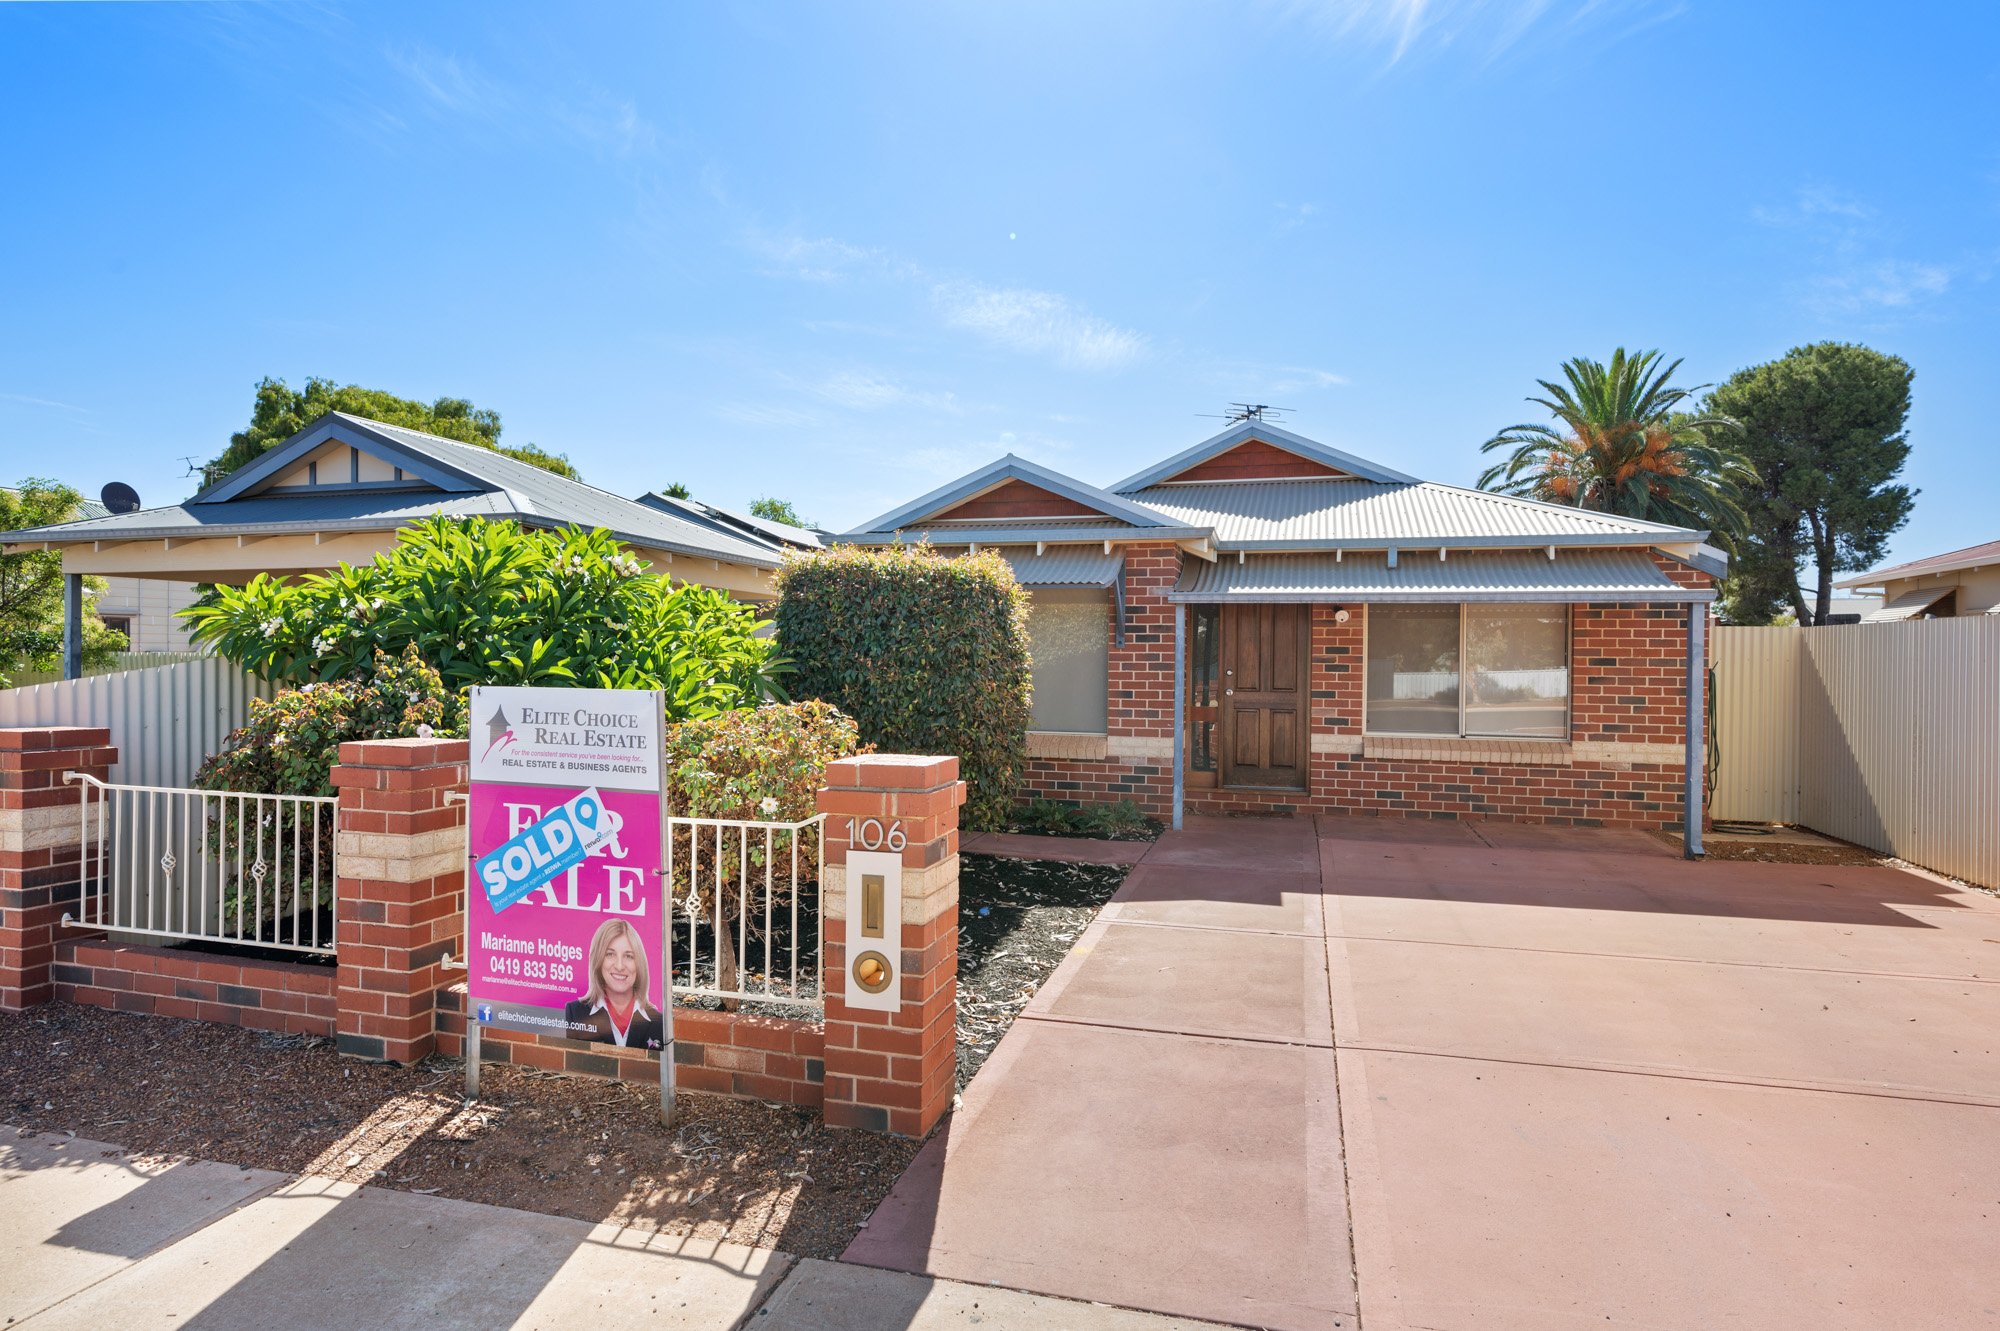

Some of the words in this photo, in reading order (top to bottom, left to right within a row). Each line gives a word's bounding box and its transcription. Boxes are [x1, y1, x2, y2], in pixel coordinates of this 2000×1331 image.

[521, 708, 570, 725] ELITE
[574, 709, 638, 728] CHOICE
[535, 728, 580, 746] REAL
[583, 730, 647, 749] ESTATE
[502, 759, 524, 767] REAL
[526, 760, 556, 769] ESTATE
[560, 761, 565, 769] &
[568, 762, 610, 772] BUSINESS
[611, 764, 647, 774] AGENTS
[531, 750, 558, 758] consistent
[578, 752, 596, 760] you've
[611, 753, 631, 763] looking
[845, 818, 907, 852] 106
[483, 819, 574, 896] SOLD
[508, 889, 517, 899] real
[516, 883, 529, 893] estate
[529, 874, 542, 886] agent
[544, 861, 561, 875] REIWA
[481, 932, 535, 955] Marianne
[538, 938, 583, 963] Hodges
[490, 956, 520, 975] 0419
[523, 961, 547, 978] 833
[550, 963, 574, 982] 596
[498, 1010, 597, 1033] elitechoicerealestate.com.au
